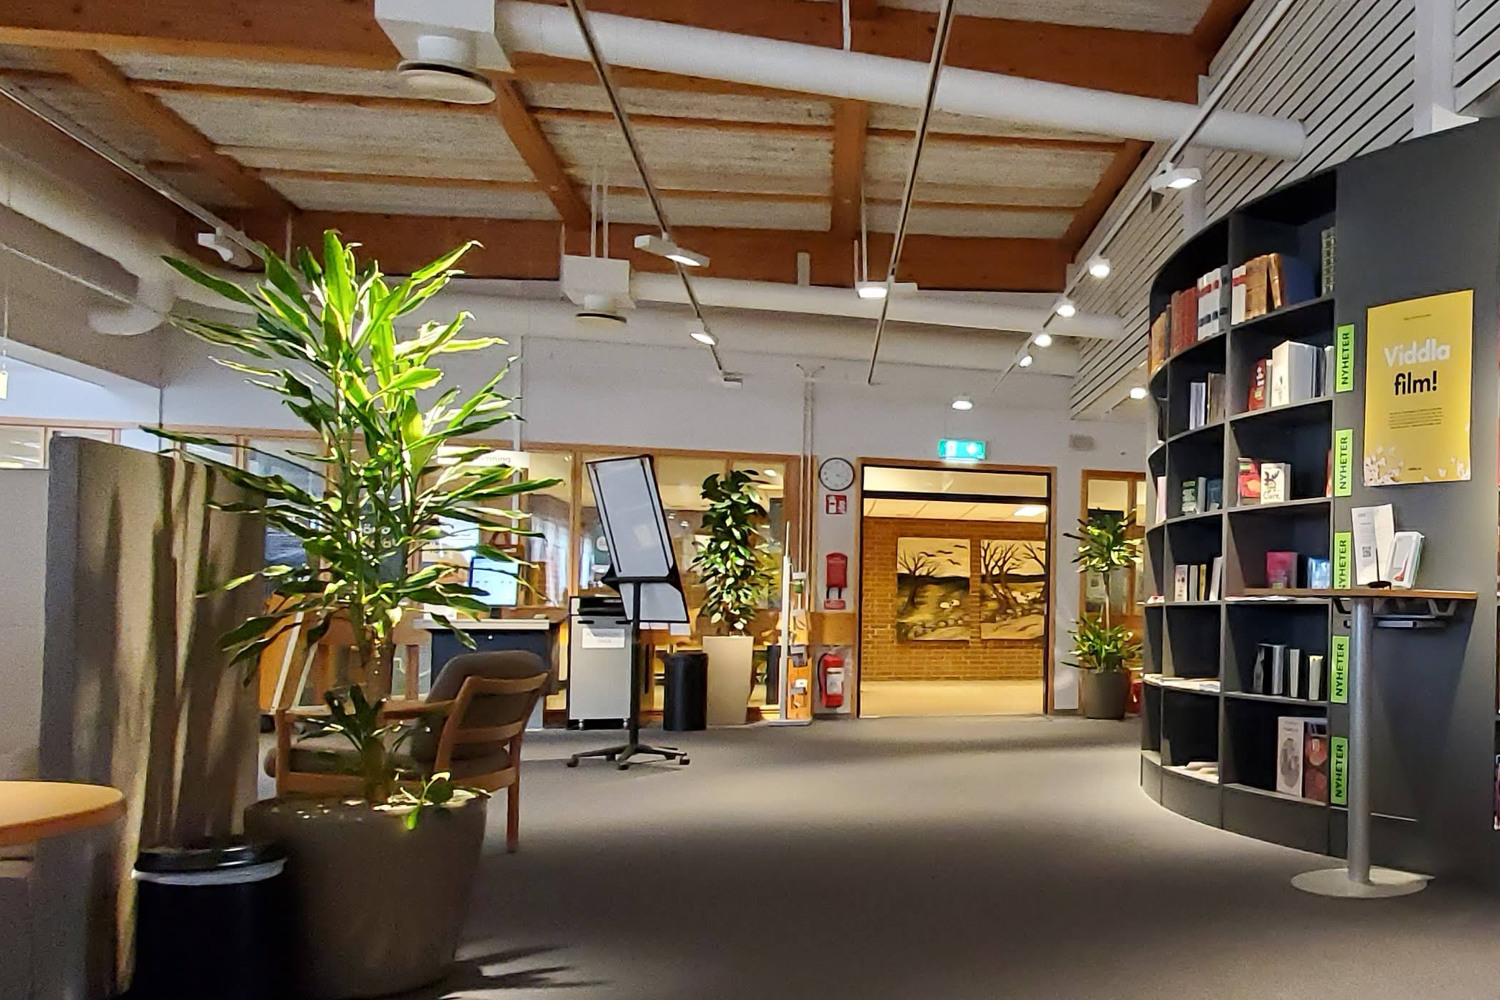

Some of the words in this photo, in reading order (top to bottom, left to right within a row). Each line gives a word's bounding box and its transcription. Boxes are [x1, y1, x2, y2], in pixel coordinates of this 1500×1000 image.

[1341, 332, 1350, 385] NYHETER
[1383, 338, 1450, 367] Viddla
[1394, 370, 1437, 395] film!
[1339, 436, 1348, 490] NYHETER
[1335, 643, 1345, 697] NYHETER
[1335, 744, 1344, 798] NYHETER
